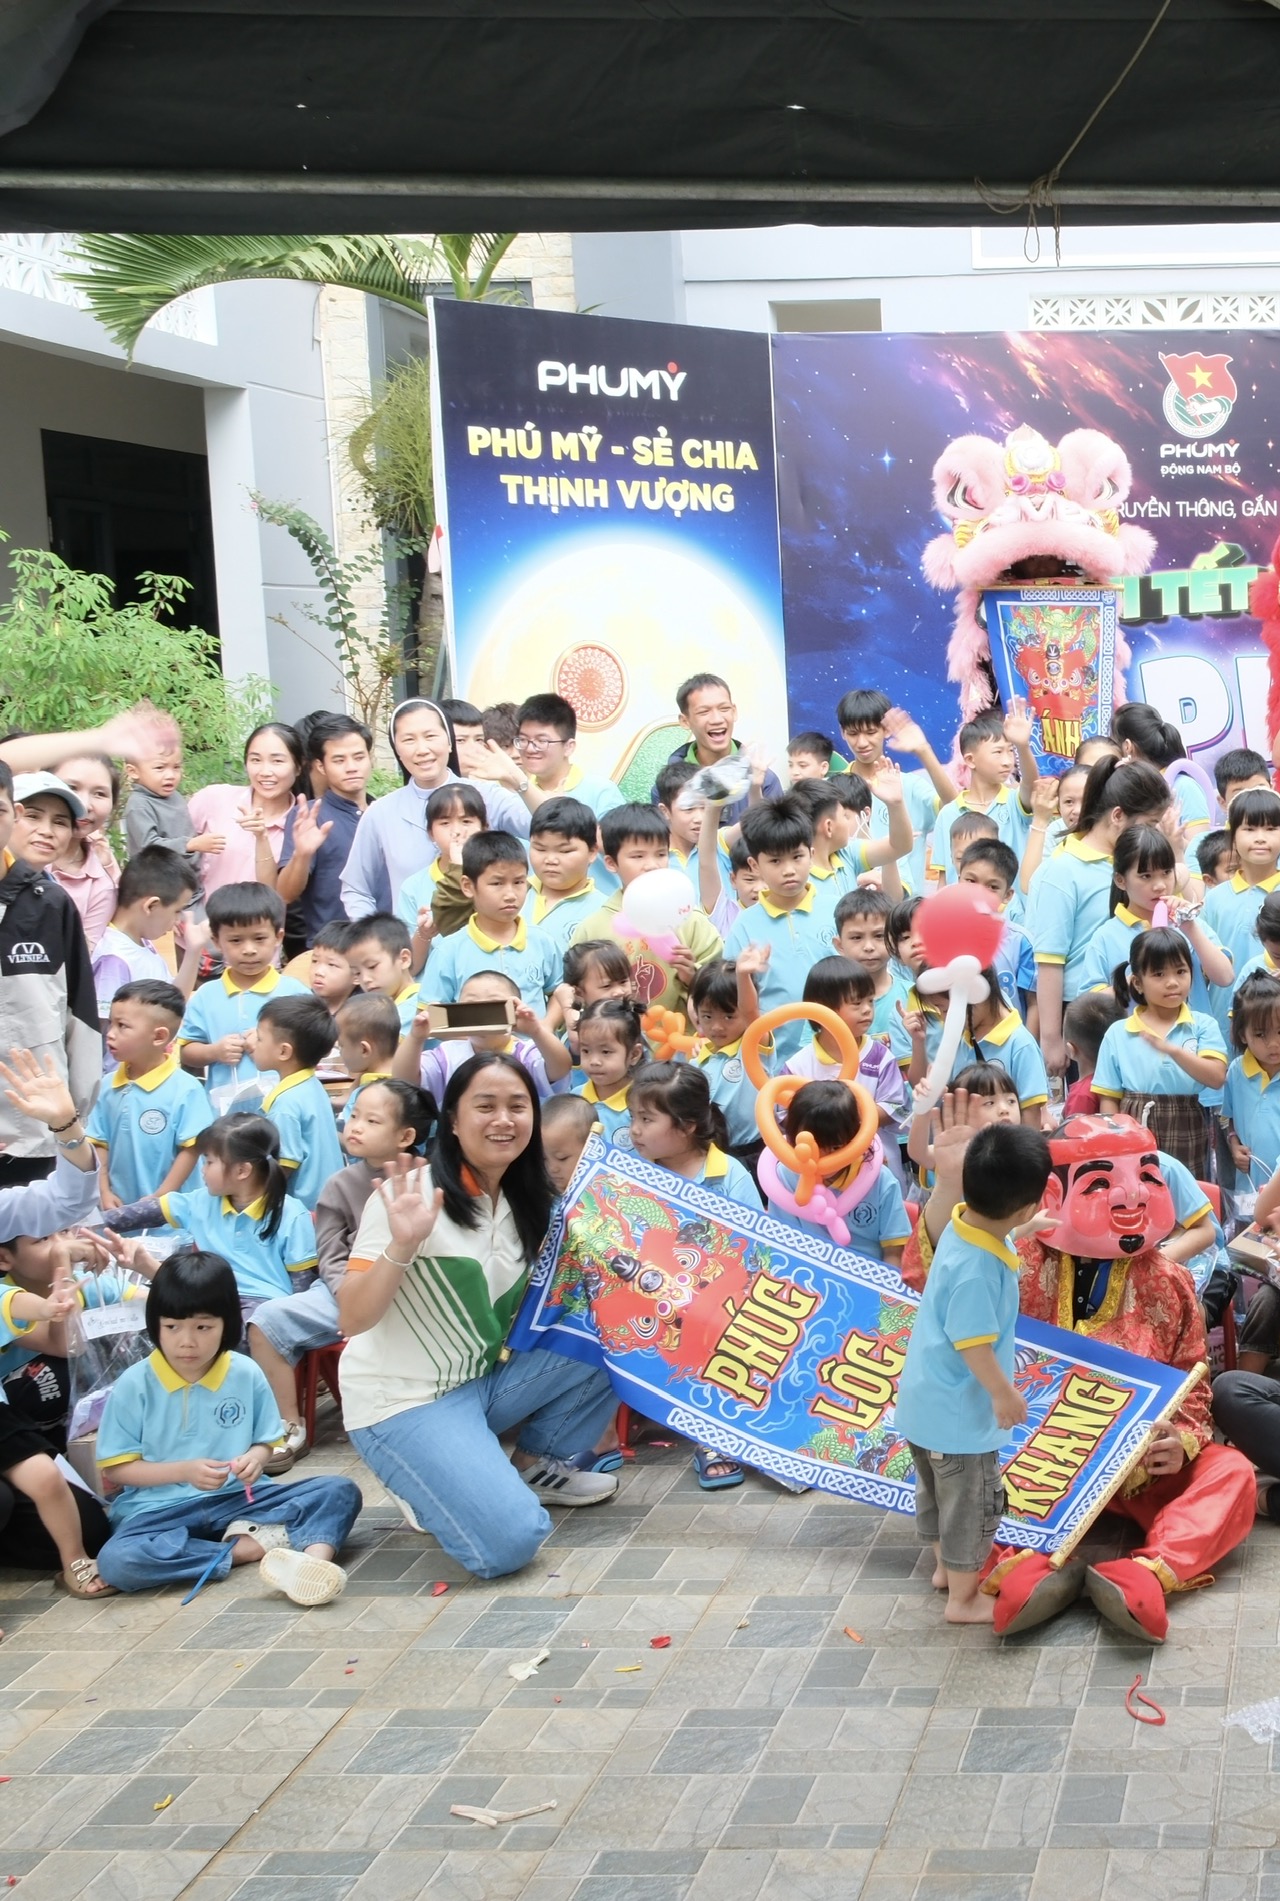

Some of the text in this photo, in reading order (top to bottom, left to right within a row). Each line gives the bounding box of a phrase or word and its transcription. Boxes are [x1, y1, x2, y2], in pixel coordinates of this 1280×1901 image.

[467, 420, 542, 460] PHÚ
[551, 425, 602, 462] MỸ
[632, 426, 674, 467] SẺ
[682, 439, 759, 471] CHIA
[1197, 465, 1222, 475] NAM
[1225, 461, 1241, 477] BỘ
[500, 474, 735, 518] THỊNH VƯỢNG
[1118, 495, 1170, 518] RUYỀN
[1242, 494, 1278, 516] GẮN
[1151, 542, 1259, 616] TẾT
[1040, 707, 1082, 759] ÁNH
[702, 1274, 818, 1406] PHÚC
[1001, 1373, 1132, 1518] KHANG
